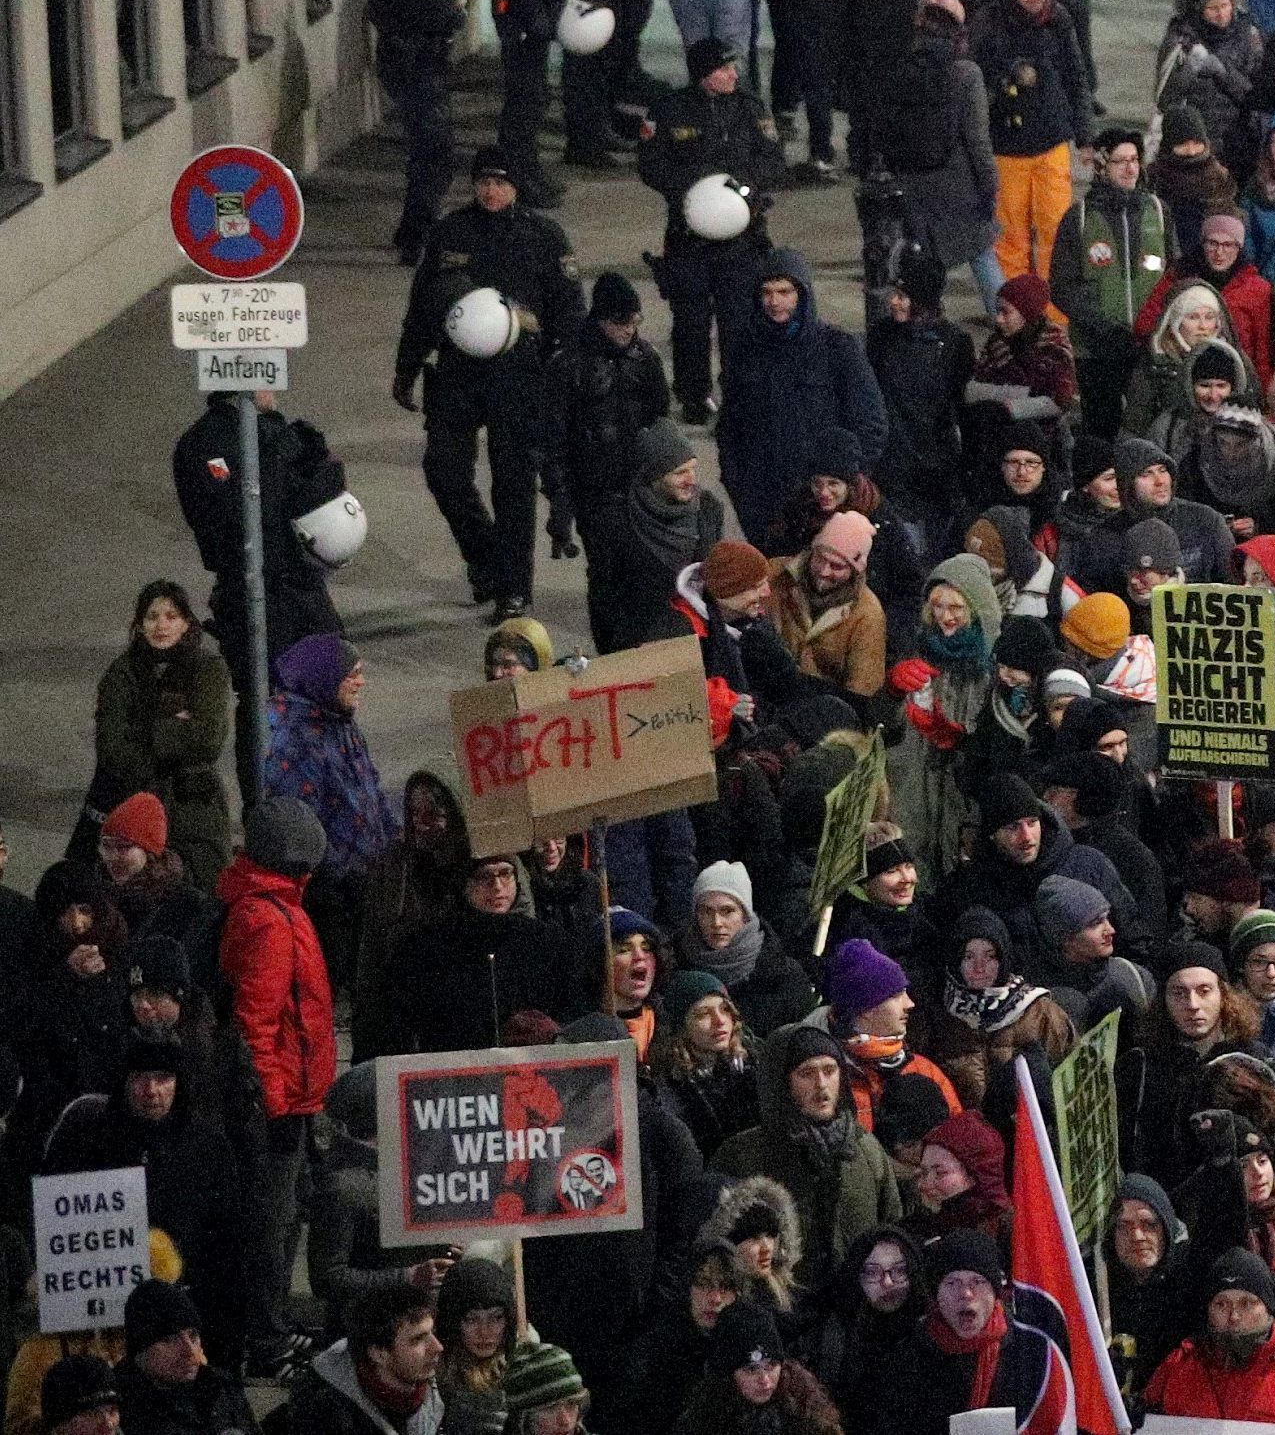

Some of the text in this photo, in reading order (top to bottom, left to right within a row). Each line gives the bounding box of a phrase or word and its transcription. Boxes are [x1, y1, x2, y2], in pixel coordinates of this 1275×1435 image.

[232, 307, 301, 324] Fahrzeuge
[209, 327, 272, 343] der OPEC
[208, 355, 277, 384] Anfang
[1164, 590, 1263, 628] LASST
[1166, 626, 1265, 664] NAZIS
[1167, 662, 1265, 701] NICHT
[1168, 697, 1266, 726] REGIEREN
[464, 681, 655, 797] RECHT
[1169, 729, 1268, 752] UND NIEMALS
[1168, 747, 1269, 766] AUFMARSCHIEREN!
[413, 1094, 499, 1130] WIEN
[451, 1127, 565, 1165] WEHRT
[416, 1170, 489, 1206] SICH
[54, 1191, 125, 1216] OMAS
[49, 1228, 135, 1254] GEGEN
[44, 1265, 145, 1294] RECHTS
